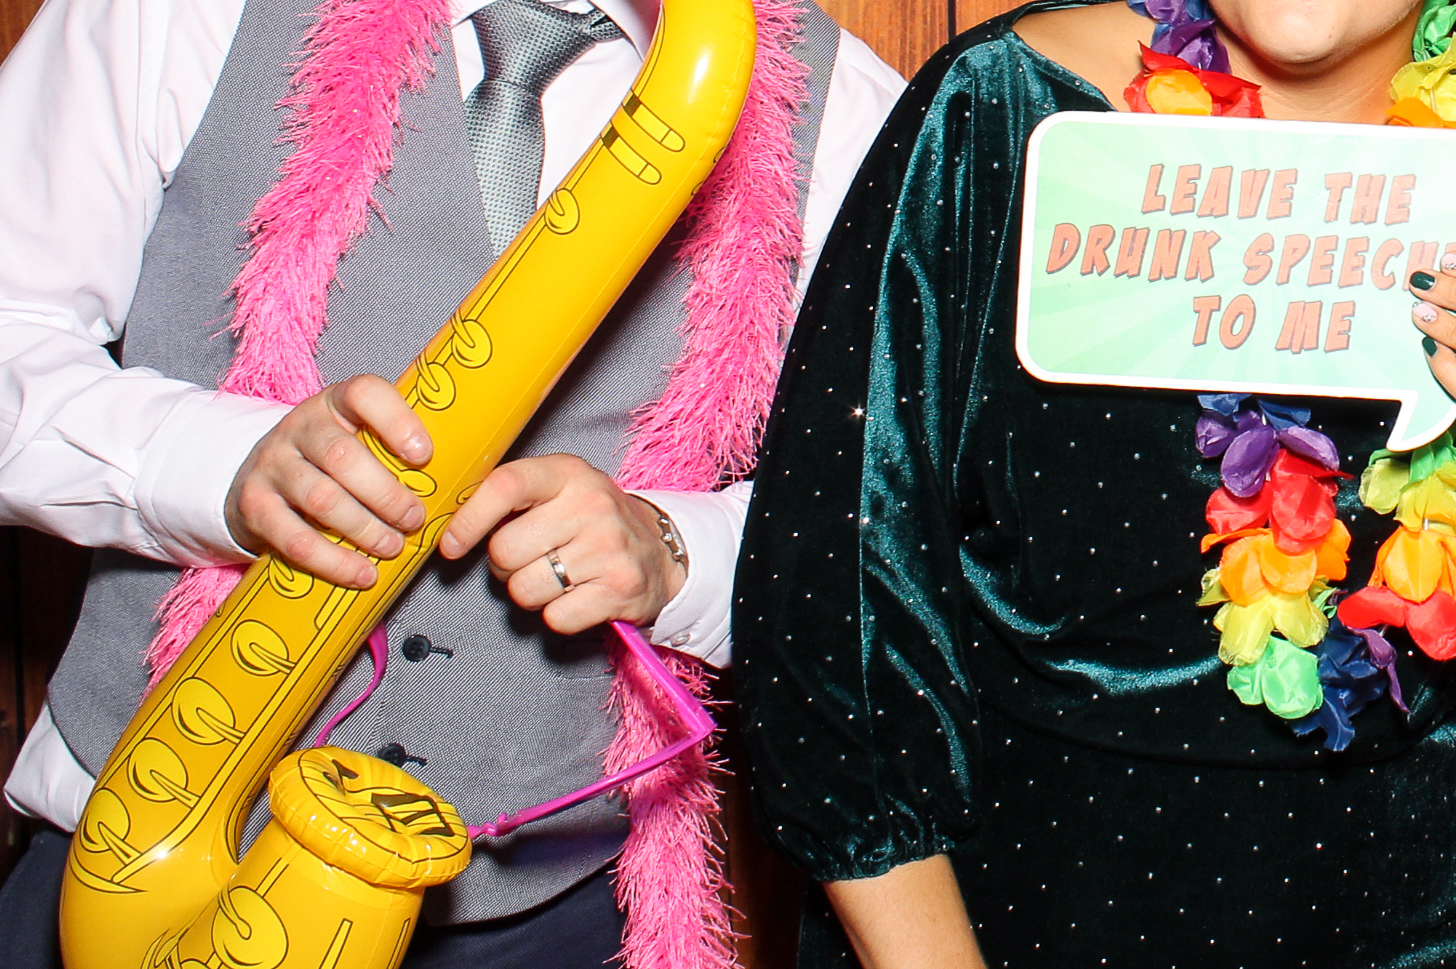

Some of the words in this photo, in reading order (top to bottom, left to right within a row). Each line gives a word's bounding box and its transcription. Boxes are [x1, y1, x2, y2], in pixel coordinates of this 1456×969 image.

[1141, 163, 1298, 220] LEAVE
[1324, 171, 1416, 226] THE
[1045, 222, 1221, 282] DRUNK
[1192, 294, 1256, 350] TO
[1275, 300, 1356, 355] ME
